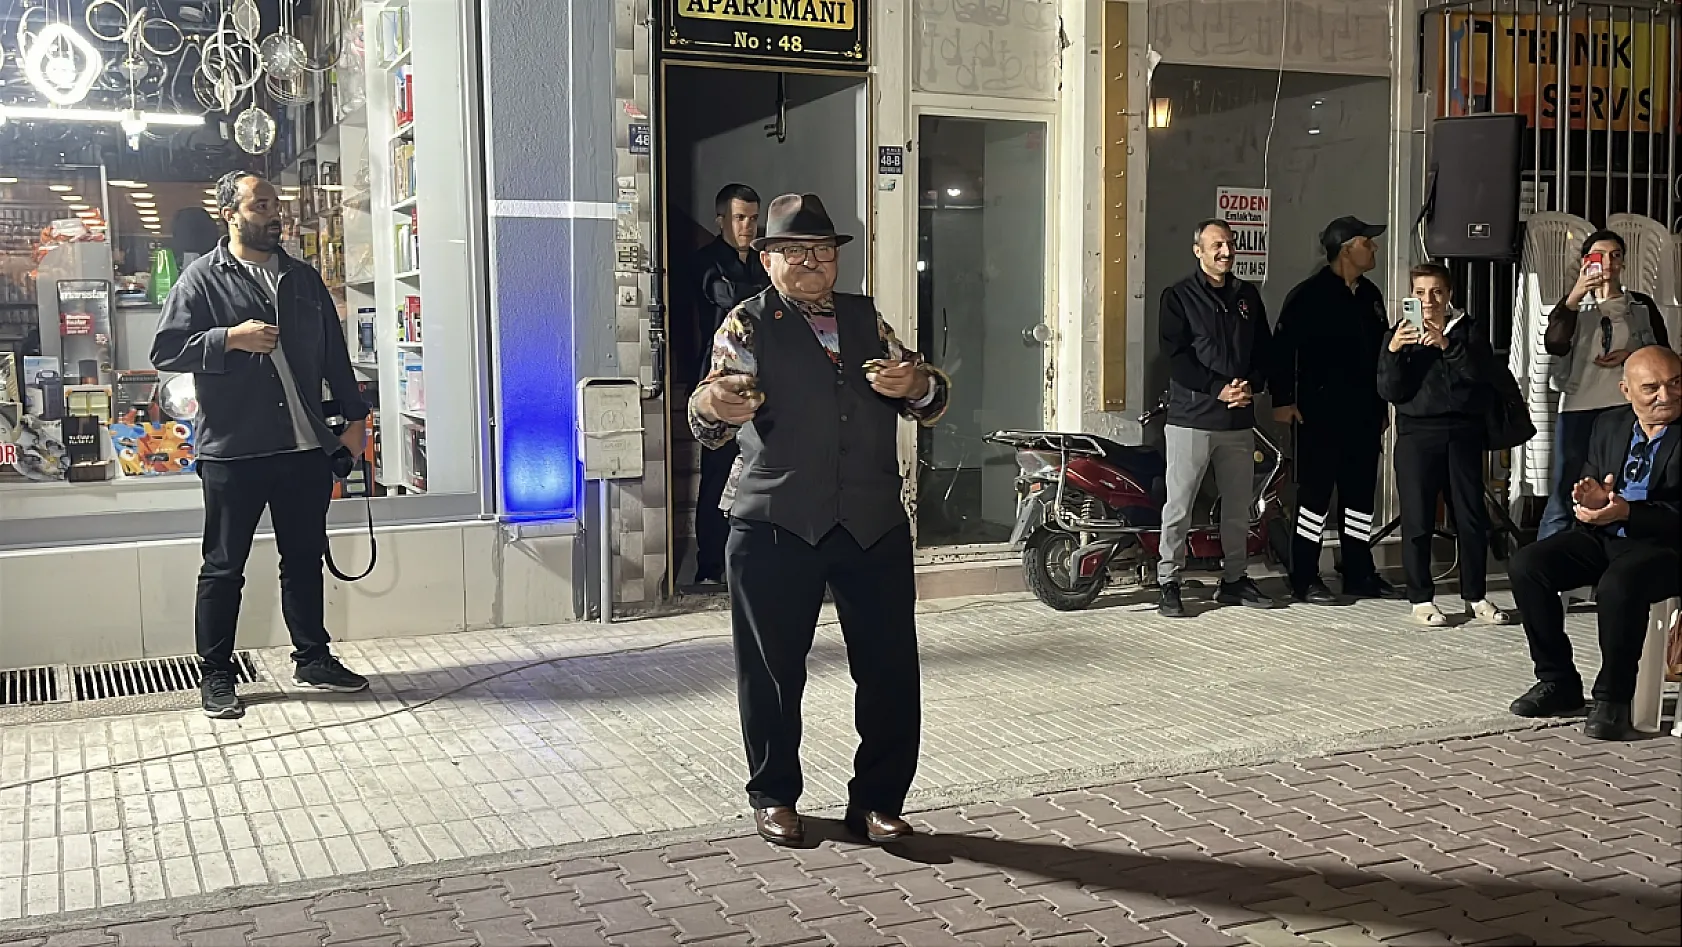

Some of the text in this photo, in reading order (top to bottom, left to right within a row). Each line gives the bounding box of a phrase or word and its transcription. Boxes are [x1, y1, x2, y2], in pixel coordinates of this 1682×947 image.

[686, 0, 846, 24] APARTMANI
[734, 31, 802, 52] No : 48
[1542, 83, 1652, 122] SERVS
[1219, 190, 1269, 211] ÖZDEN
[1231, 230, 1267, 251] RALIK
